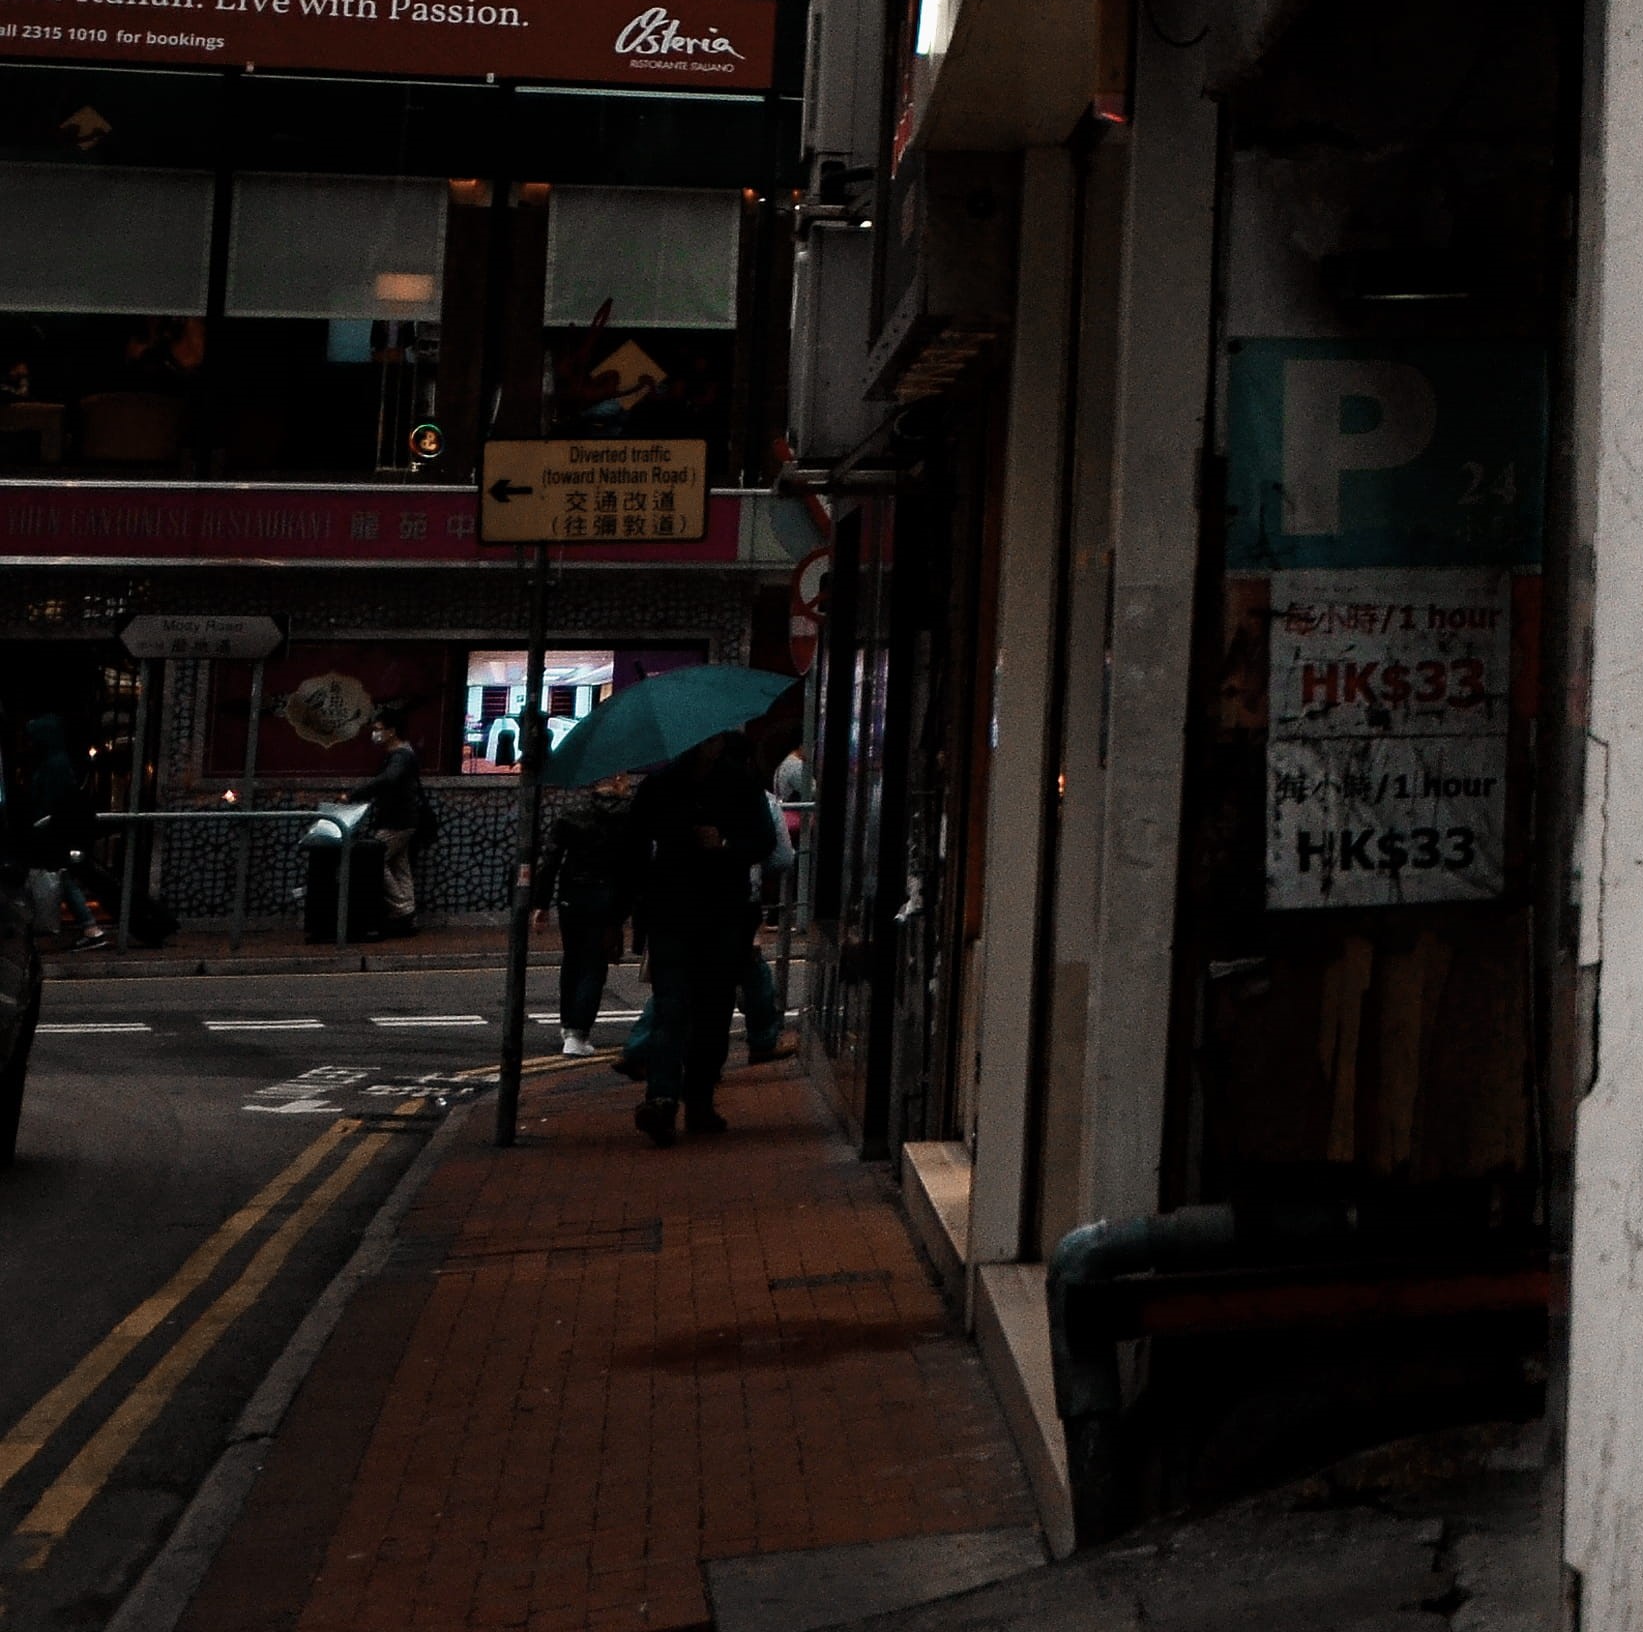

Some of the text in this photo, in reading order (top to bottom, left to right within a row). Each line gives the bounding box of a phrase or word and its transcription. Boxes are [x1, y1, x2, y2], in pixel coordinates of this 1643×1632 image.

[0, 24, 226, 52] all 2315 1010 for bookings
[614, 6, 747, 61] Osteria
[569, 444, 672, 465] Diverted traffic
[1280, 358, 1440, 537] P
[542, 468, 595, 489] (toward
[598, 466, 648, 485] Nathan
[1457, 460, 1522, 505] 24
[565, 490, 676, 513] 交通改道
[1427, 604, 1503, 631] hour
[1301, 658, 1487, 709] HK$33
[1423, 770, 1497, 798] hour
[1297, 826, 1475, 873] HK$33
